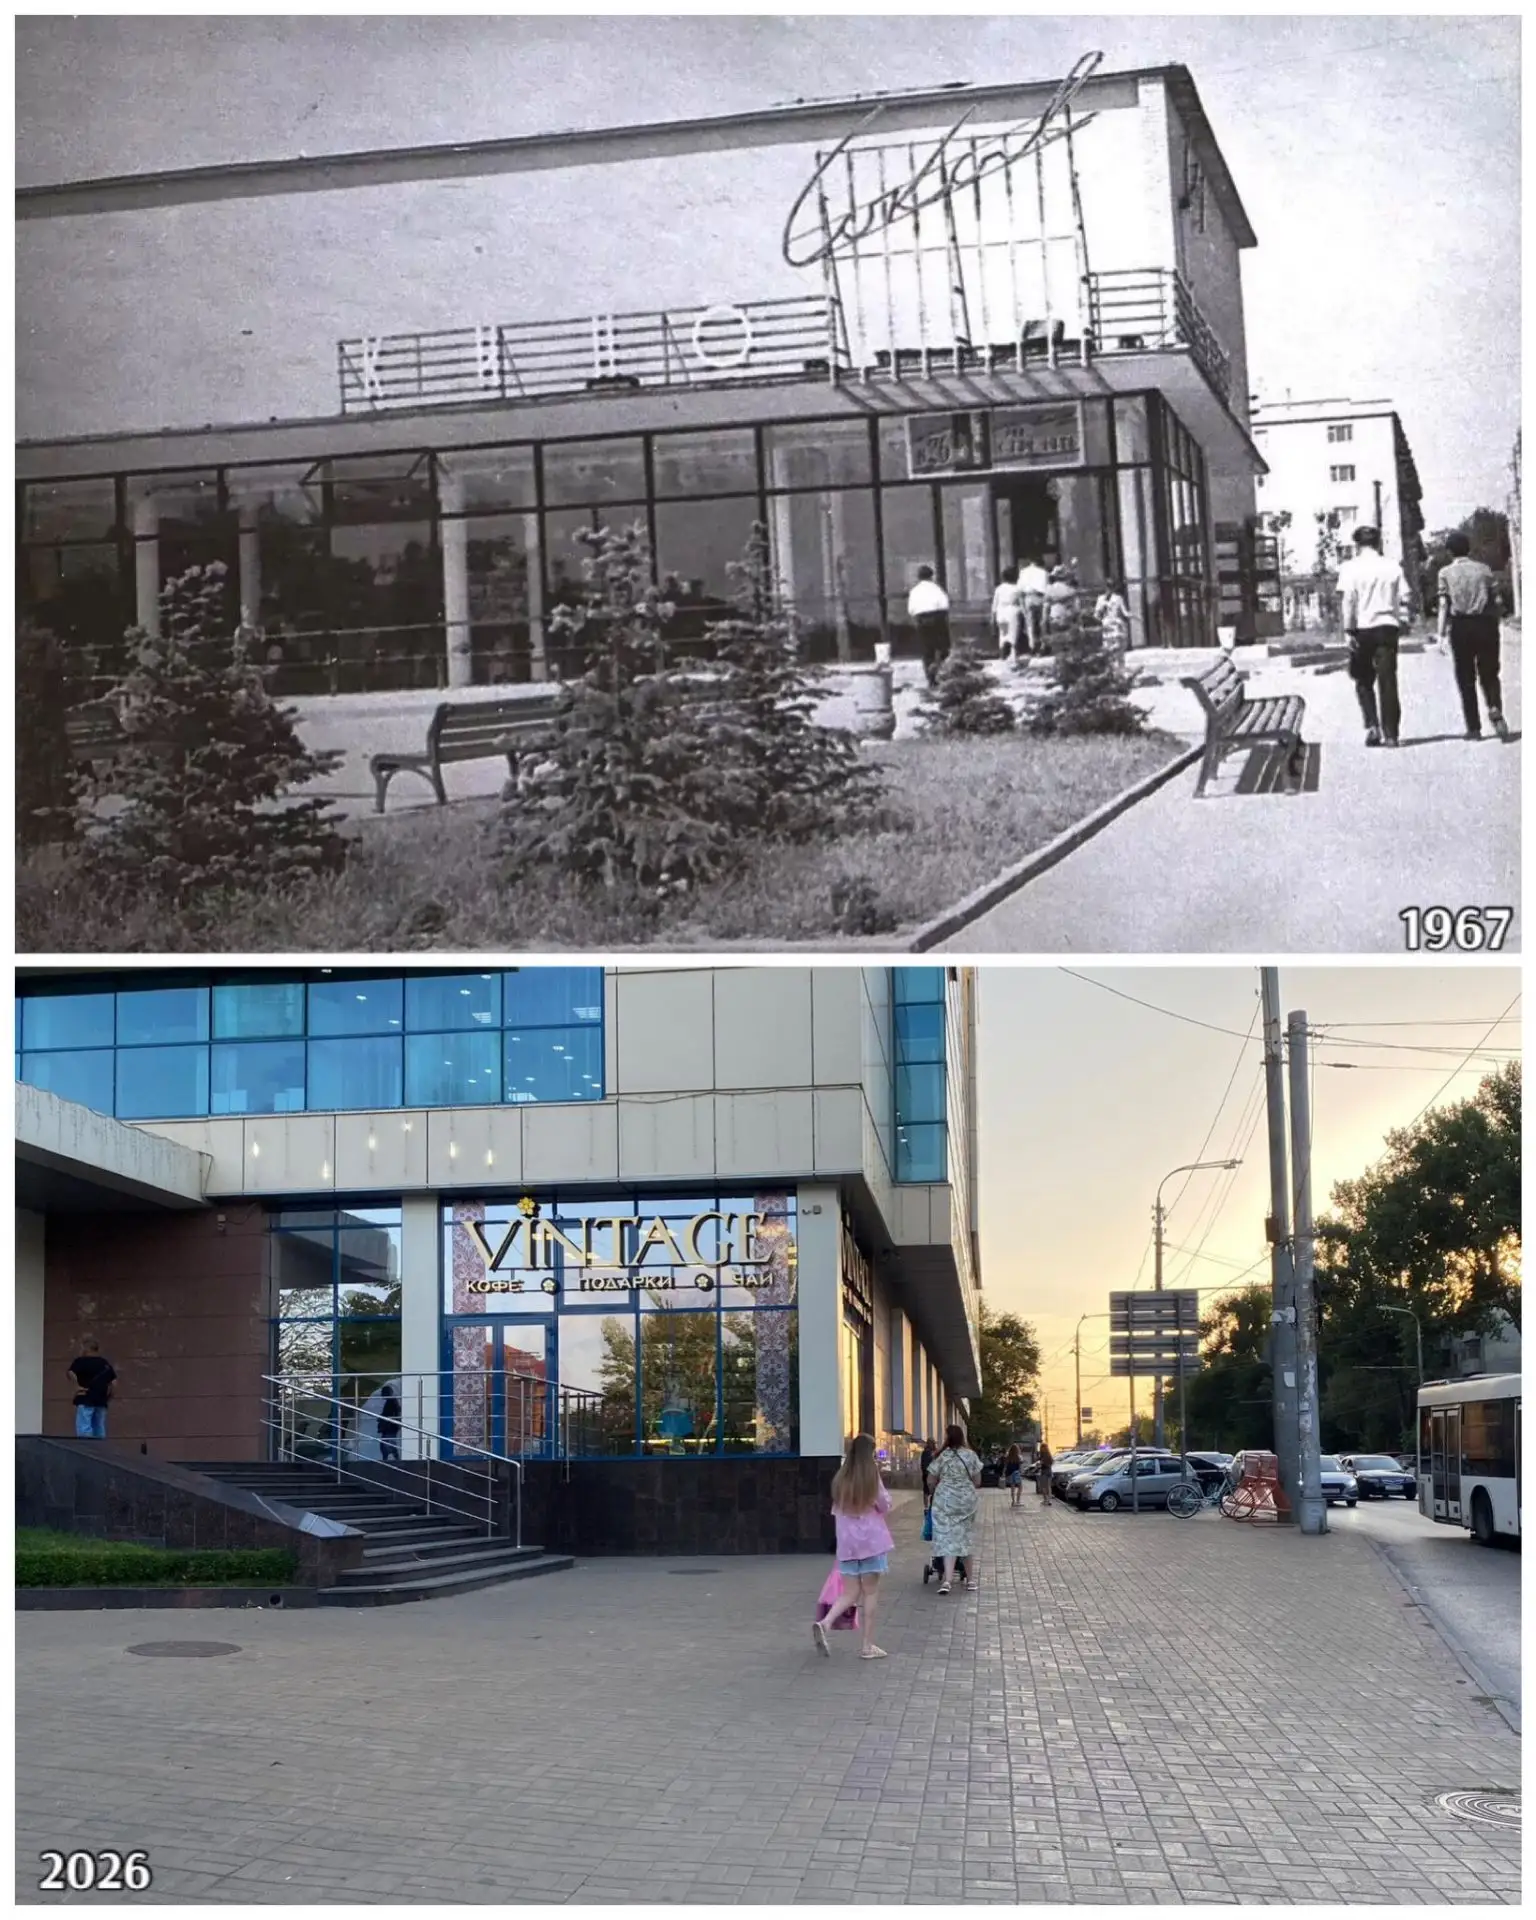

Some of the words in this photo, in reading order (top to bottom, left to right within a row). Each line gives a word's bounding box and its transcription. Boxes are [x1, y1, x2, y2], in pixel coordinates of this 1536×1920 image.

[363, 304, 753, 398] КИНО
[461, 1210, 773, 1271] VINTAGE
[466, 1279, 523, 1293] КОФЕ
[578, 1275, 673, 1291] ПОДАРКИ
